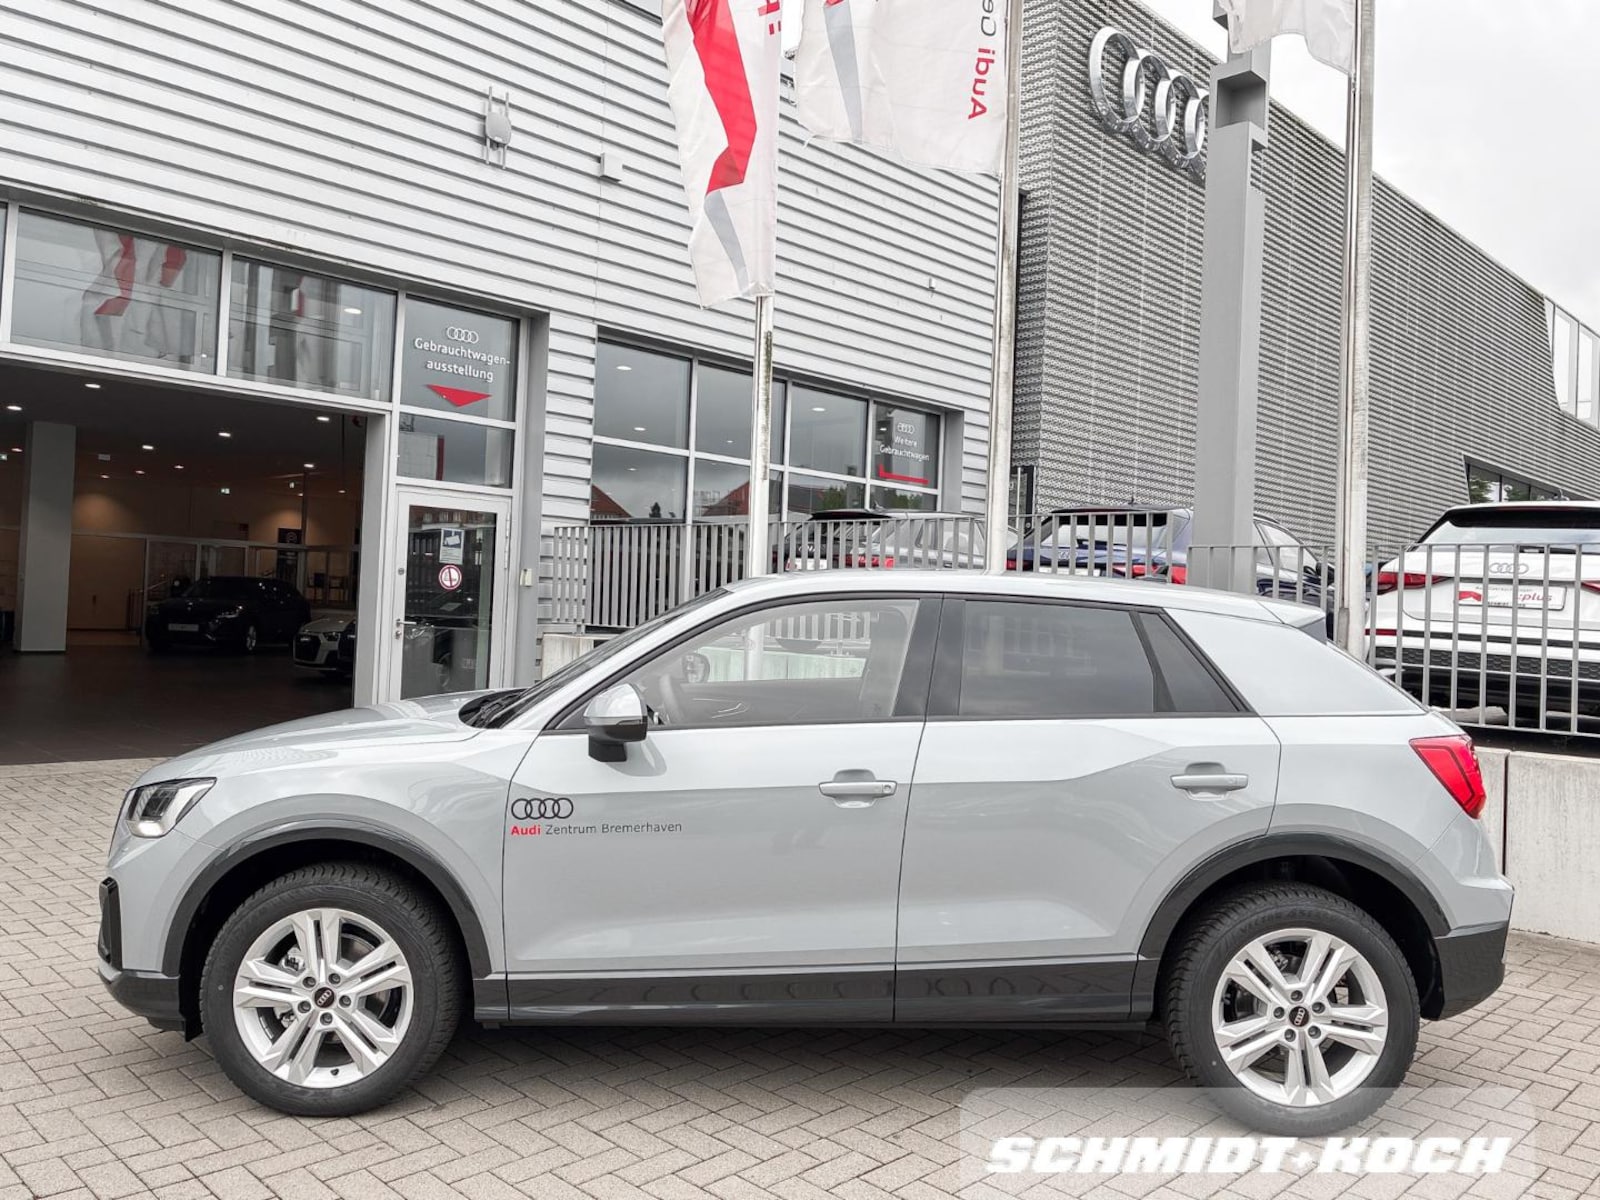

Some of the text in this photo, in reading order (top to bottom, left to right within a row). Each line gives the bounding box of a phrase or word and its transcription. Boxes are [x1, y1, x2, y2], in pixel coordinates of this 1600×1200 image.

[414, 337, 511, 366] Gebrauchtwagen-
[426, 359, 494, 383] ausstellung
[879, 444, 930, 461] Gebrauchtwagen
[510, 822, 683, 836] Audi Zentrum Bremerhaven
